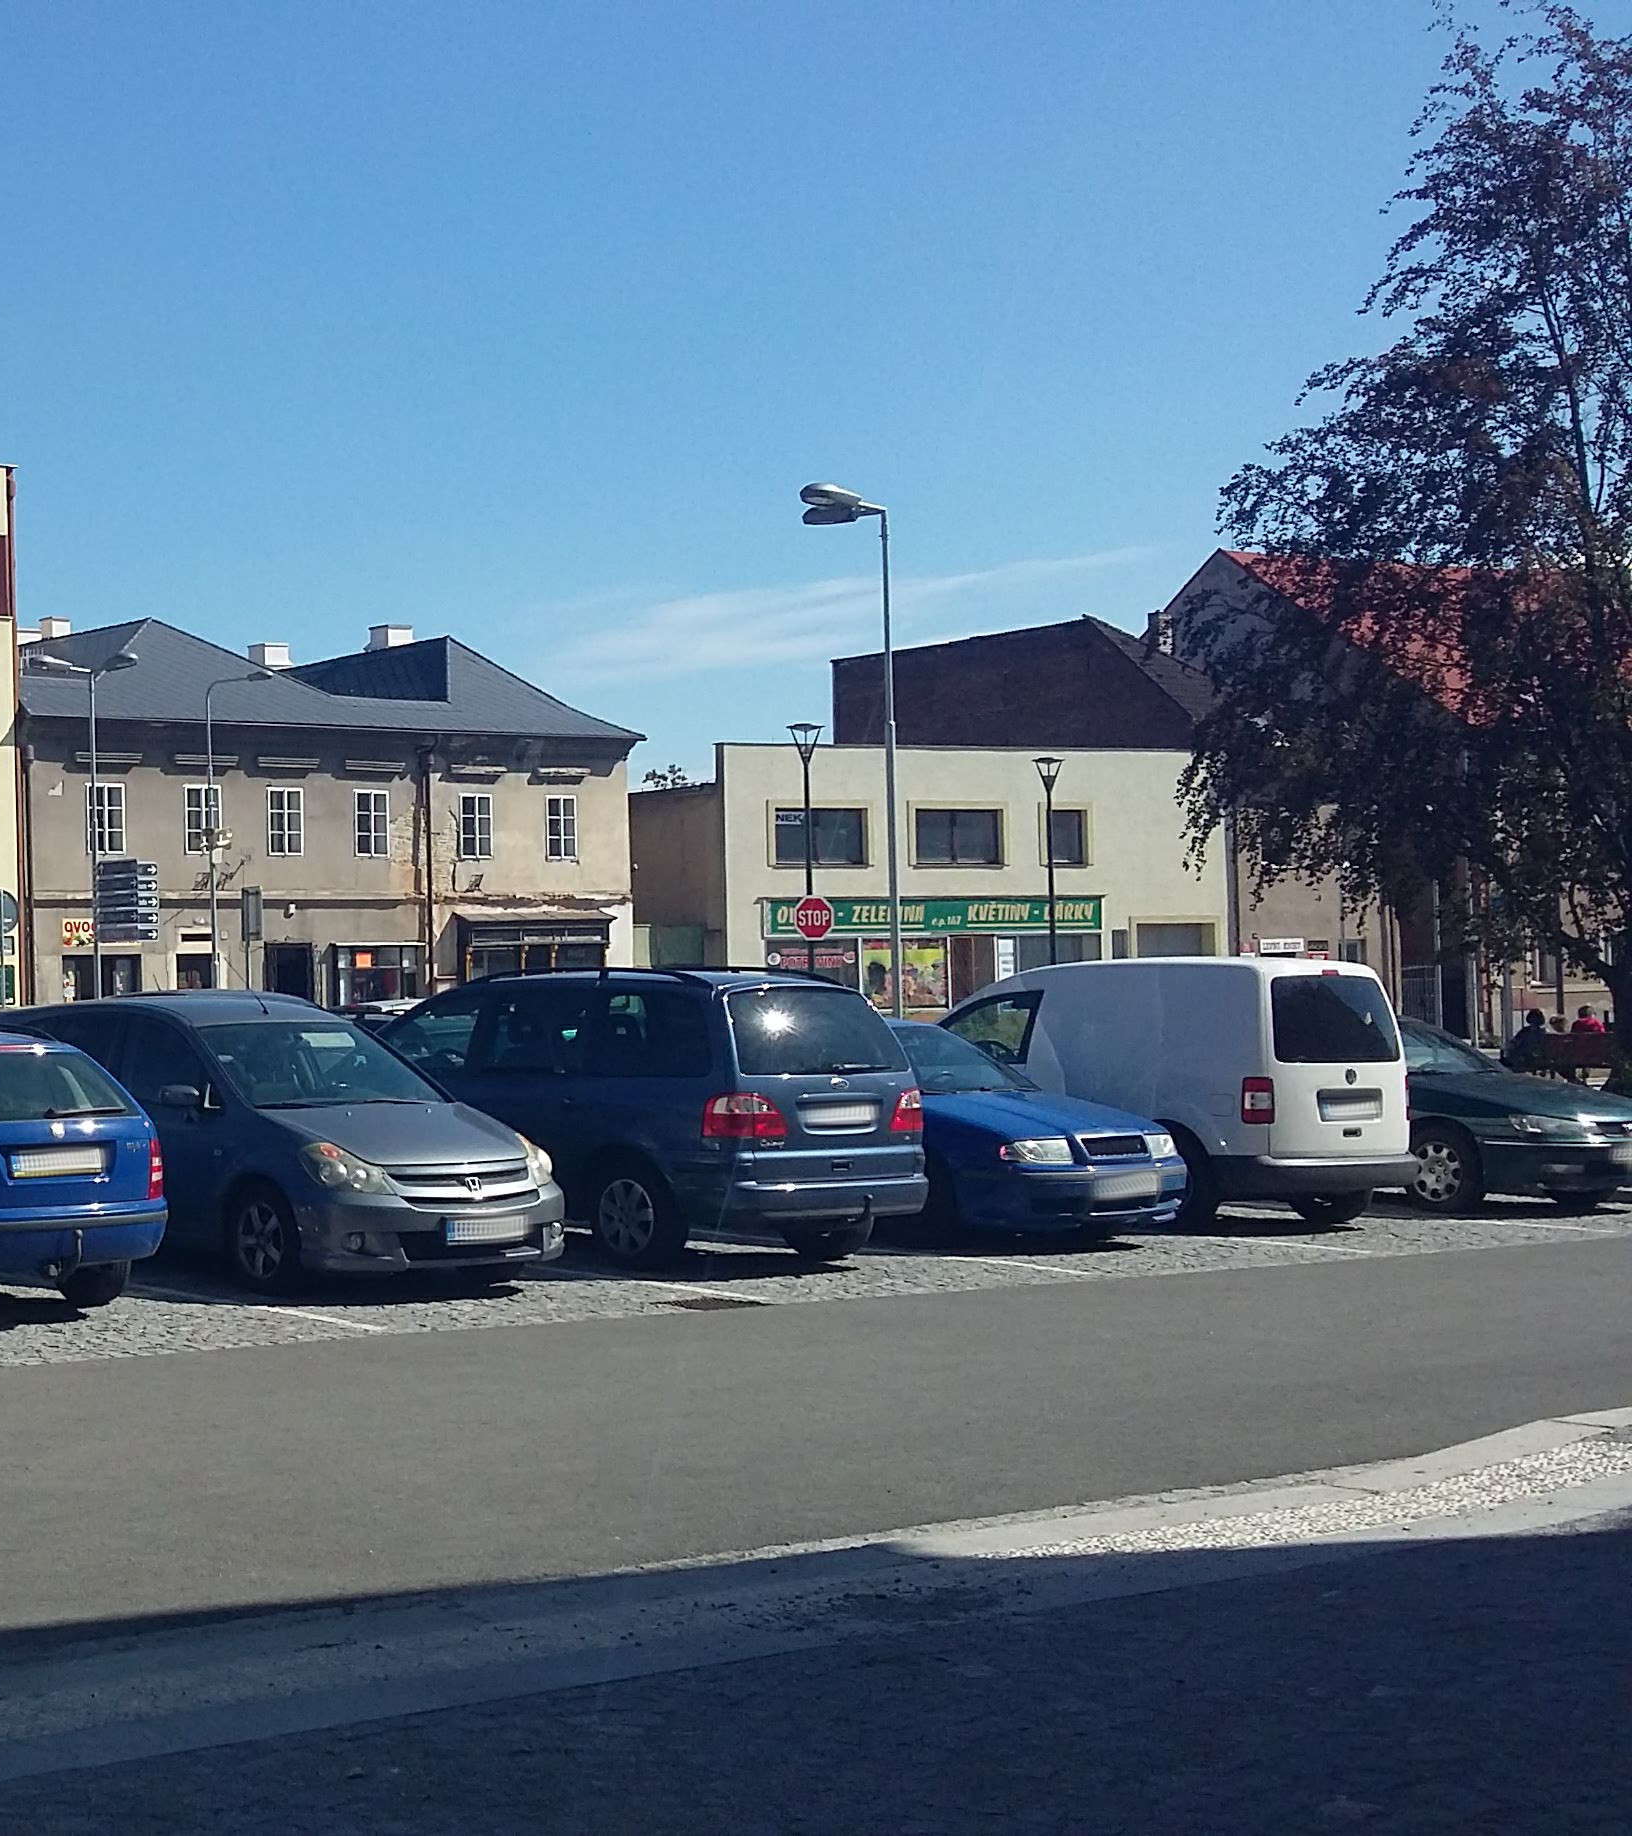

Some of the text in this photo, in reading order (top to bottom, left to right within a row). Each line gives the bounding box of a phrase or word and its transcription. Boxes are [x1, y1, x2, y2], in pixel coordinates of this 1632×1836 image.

[798, 910, 830, 927] STOP
[968, 902, 1030, 921] KVĚTINY
[1043, 901, 1094, 920] ÁRKY
